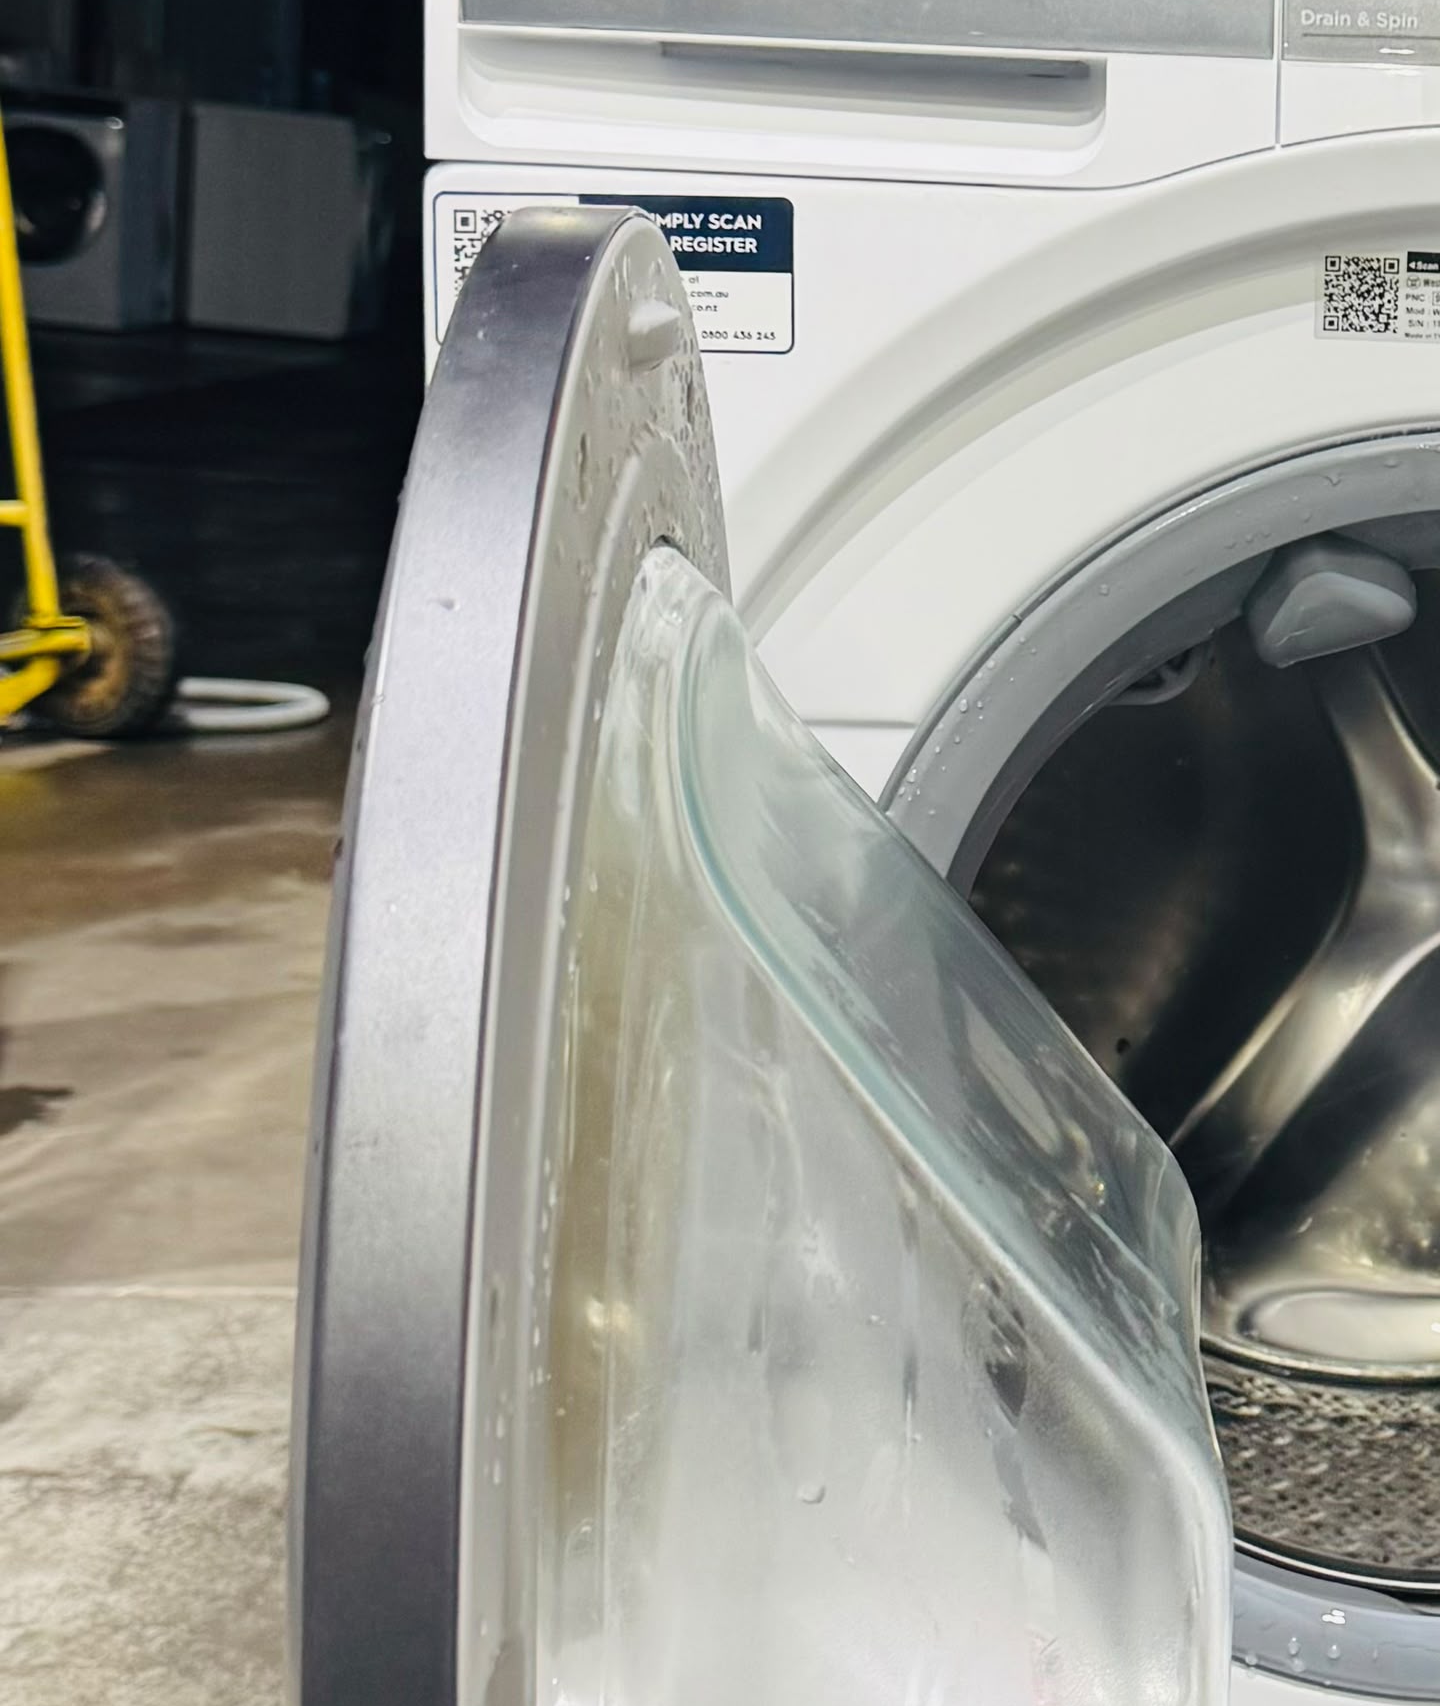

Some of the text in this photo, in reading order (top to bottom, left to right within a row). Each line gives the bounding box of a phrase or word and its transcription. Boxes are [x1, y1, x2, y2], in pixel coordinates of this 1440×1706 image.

[1300, 9, 1419, 31] Drain & Spin
[650, 212, 763, 231] IMPLY SCAN
[669, 235, 758, 253] REGISTER
[1416, 260, 1440, 271] Scan
[1405, 293, 1426, 303] PNC
